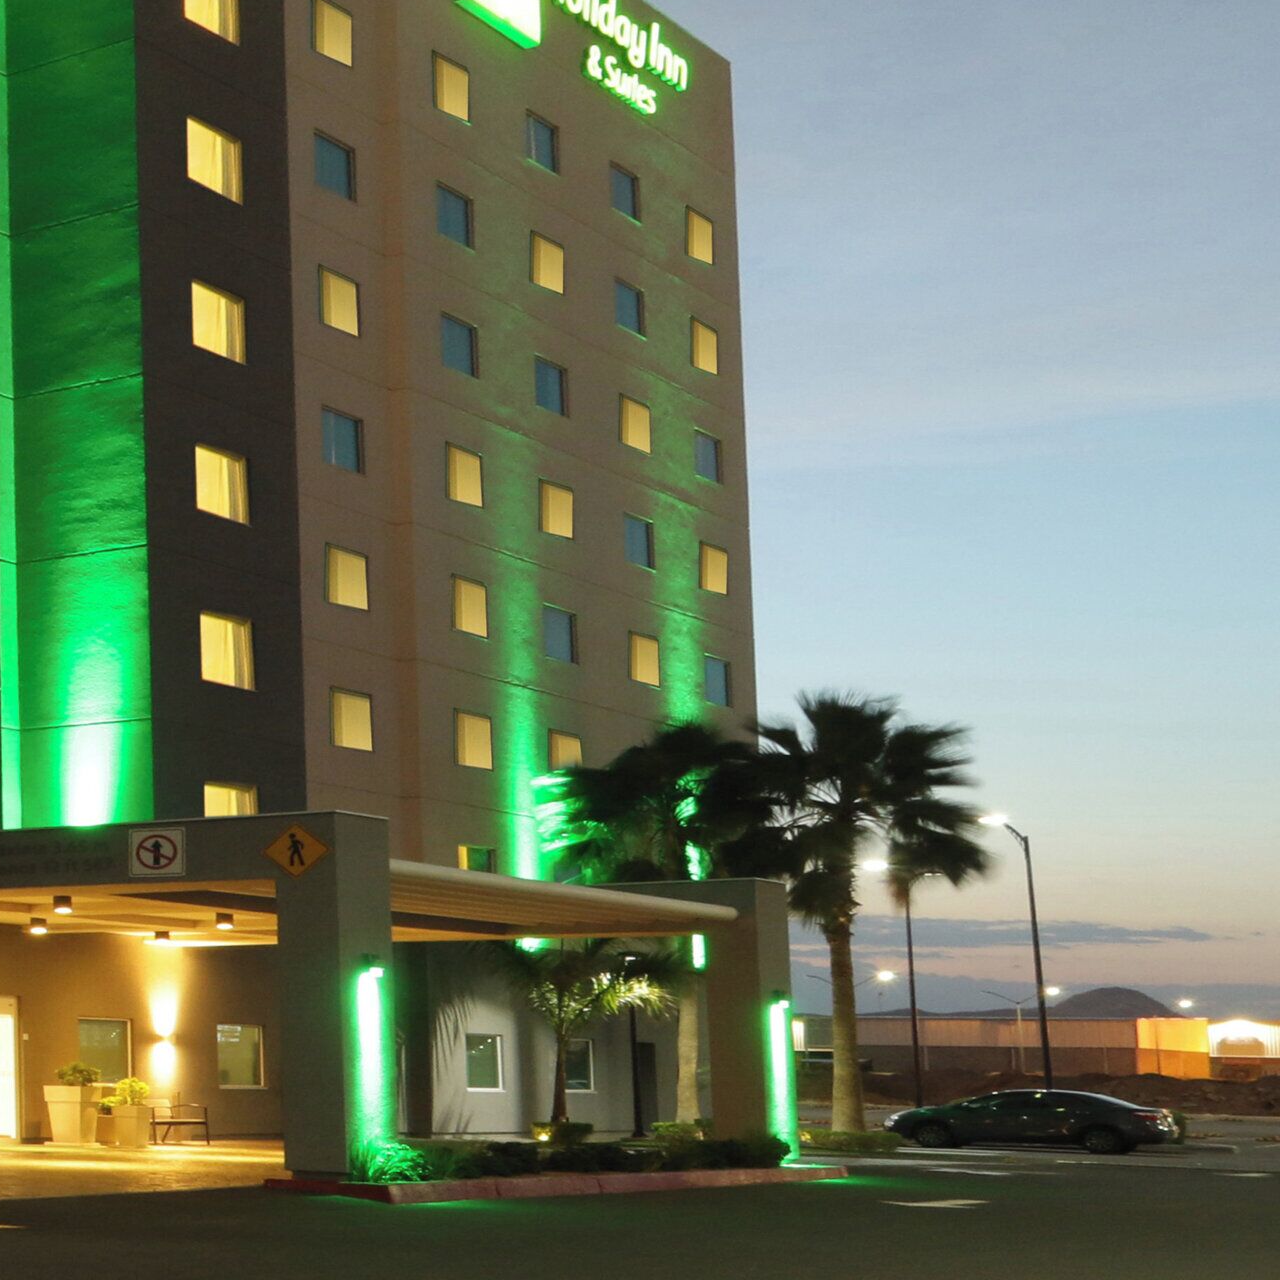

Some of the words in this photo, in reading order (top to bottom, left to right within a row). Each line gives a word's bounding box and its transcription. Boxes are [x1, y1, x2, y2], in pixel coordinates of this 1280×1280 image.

[586, 45, 603, 81] &
[604, 55, 657, 115] Suites
[649, 22, 689, 92] Inn
